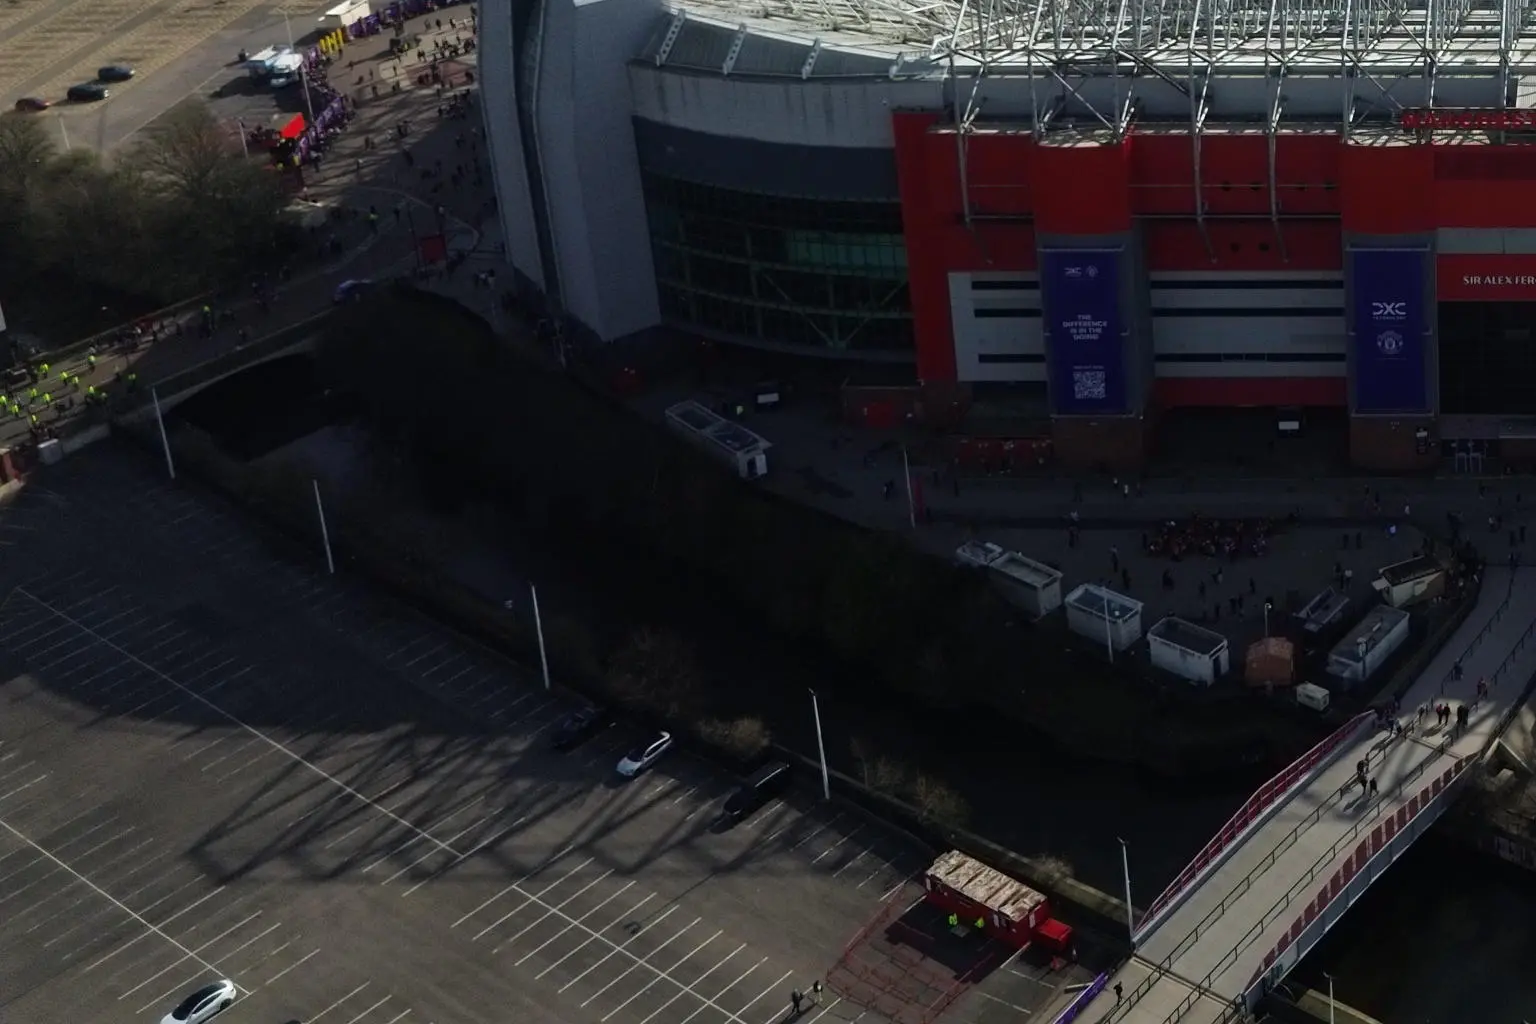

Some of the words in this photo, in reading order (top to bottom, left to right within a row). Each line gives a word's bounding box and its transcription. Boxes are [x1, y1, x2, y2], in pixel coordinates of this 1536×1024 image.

[1463, 275, 1481, 285] SIR
[1484, 275, 1513, 285] ALEX
[1372, 302, 1406, 316] DXC
